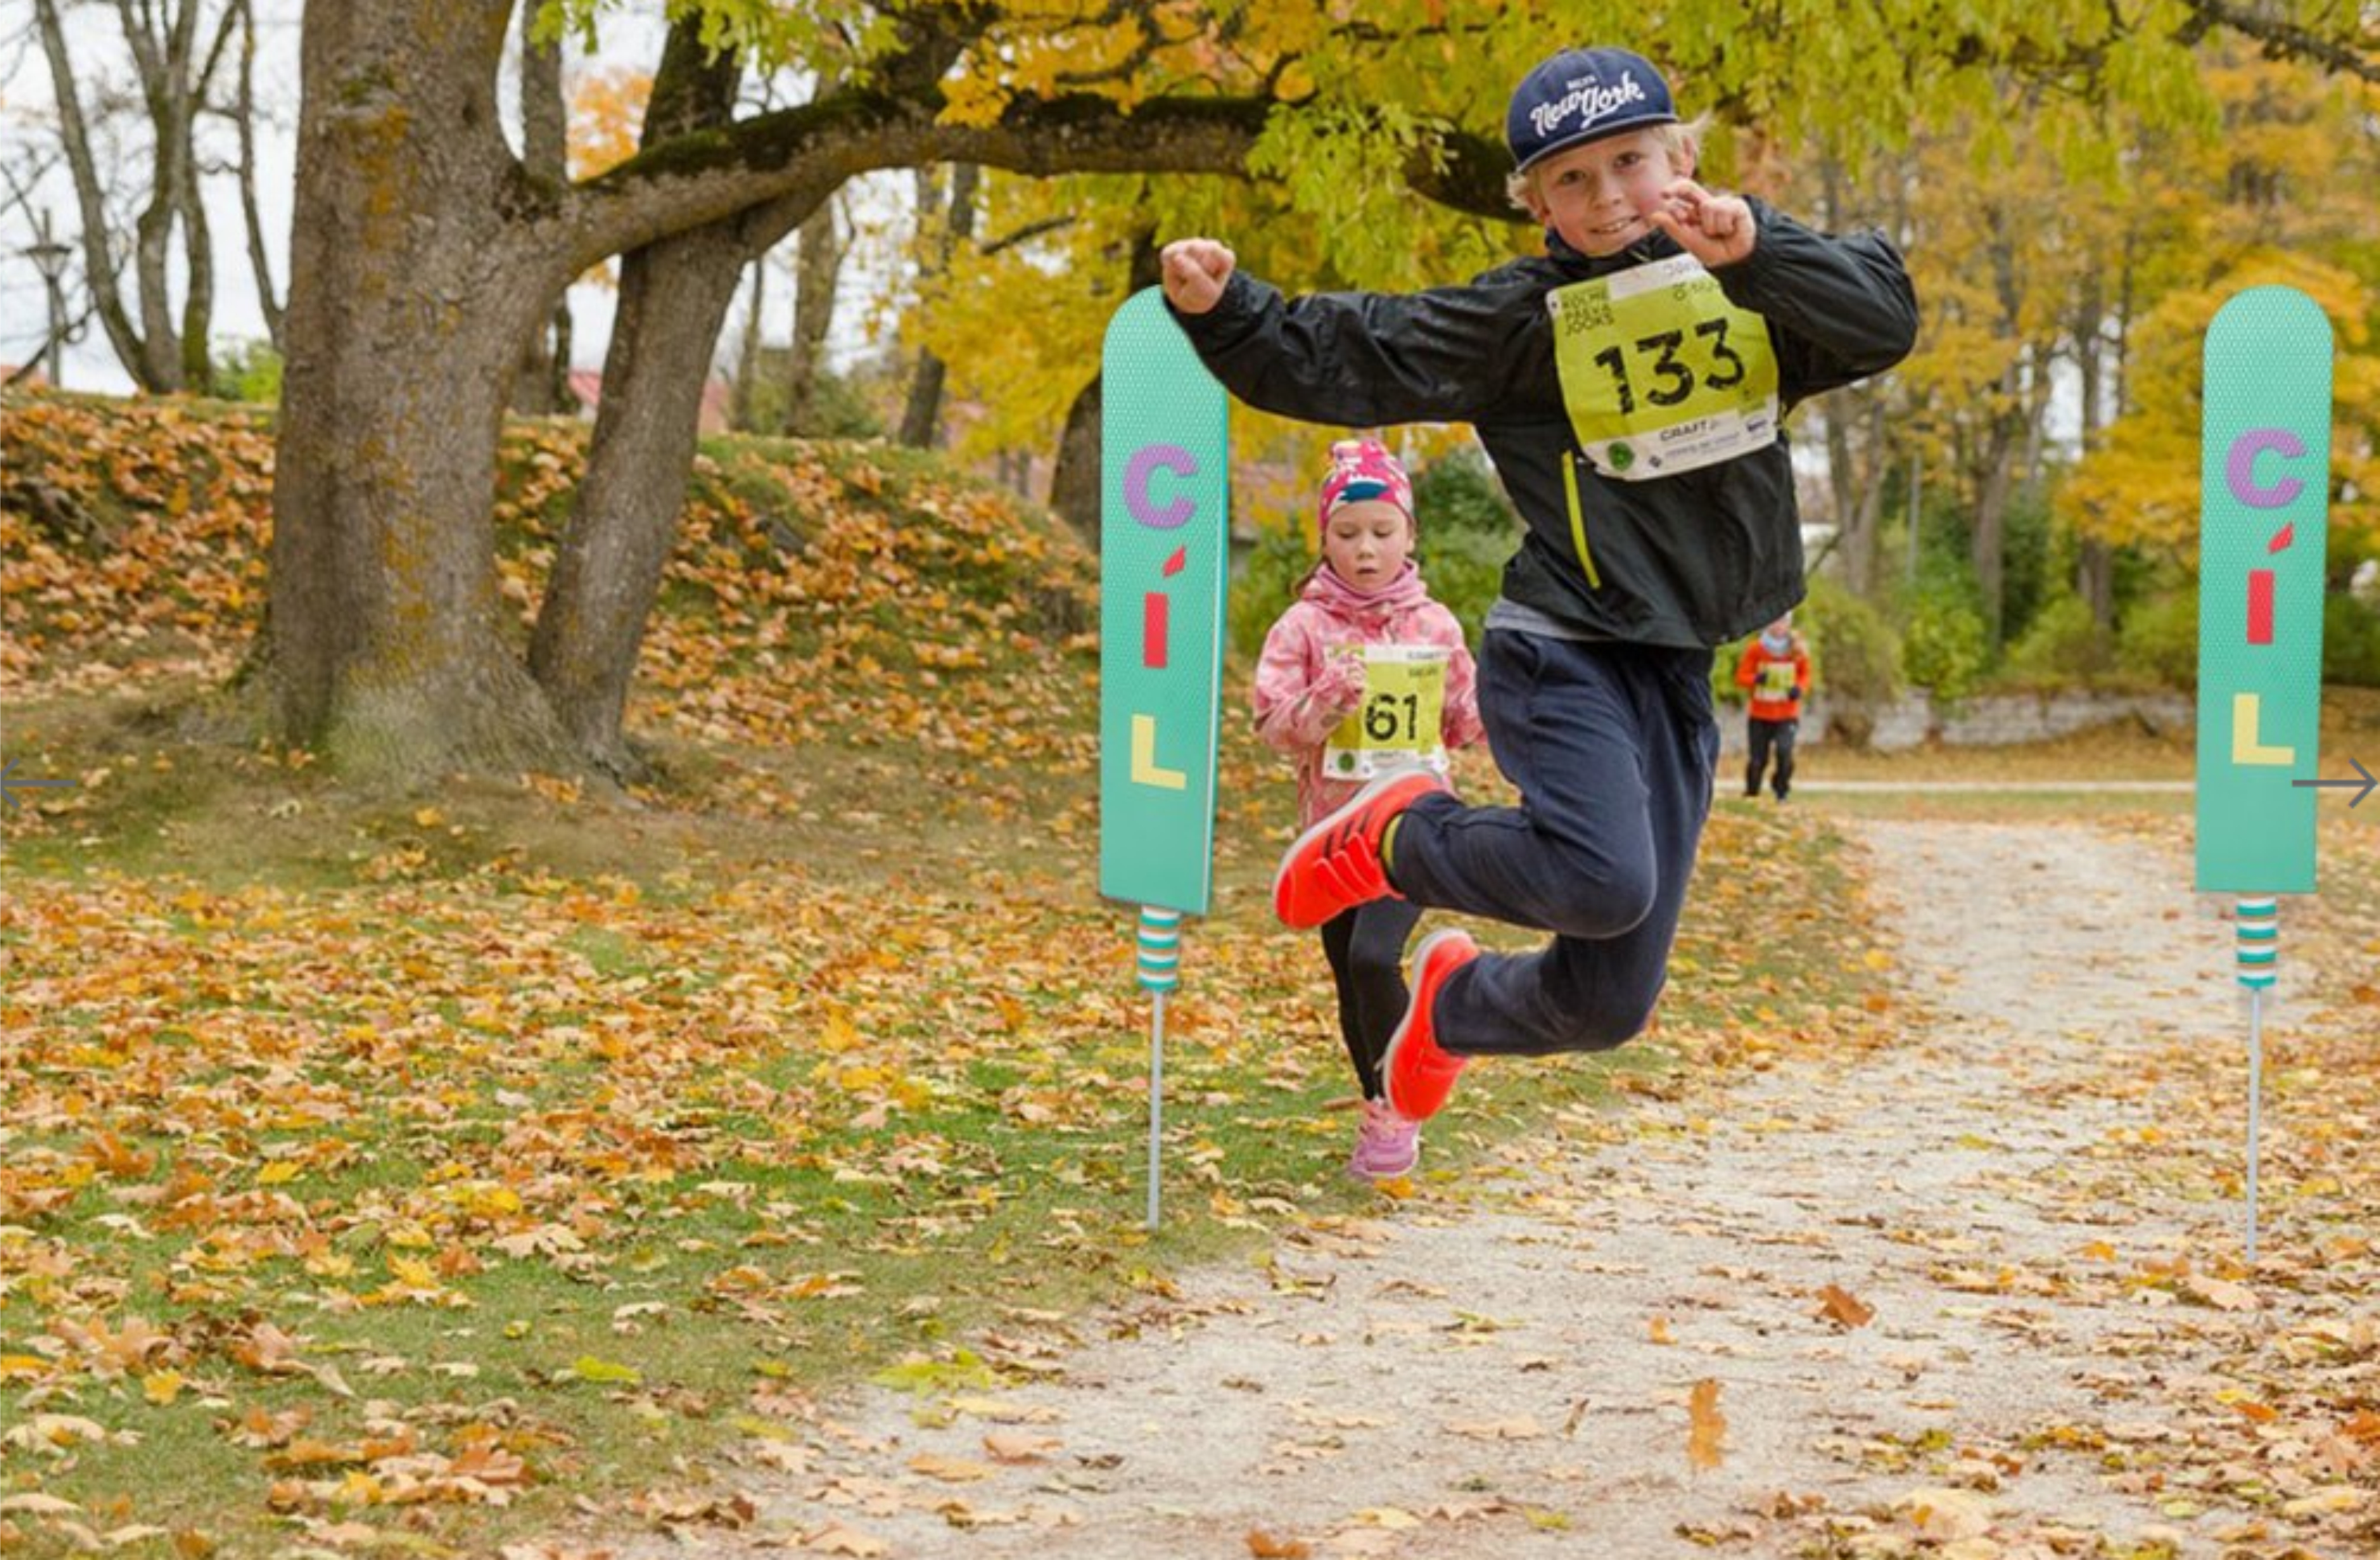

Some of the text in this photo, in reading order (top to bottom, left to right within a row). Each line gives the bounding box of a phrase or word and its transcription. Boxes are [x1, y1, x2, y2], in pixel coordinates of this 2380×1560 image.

[1594, 317, 1745, 416] 133
[1122, 443, 1199, 790] CÍL
[2226, 427, 2307, 766] CÍL
[1365, 693, 1418, 741] 61
